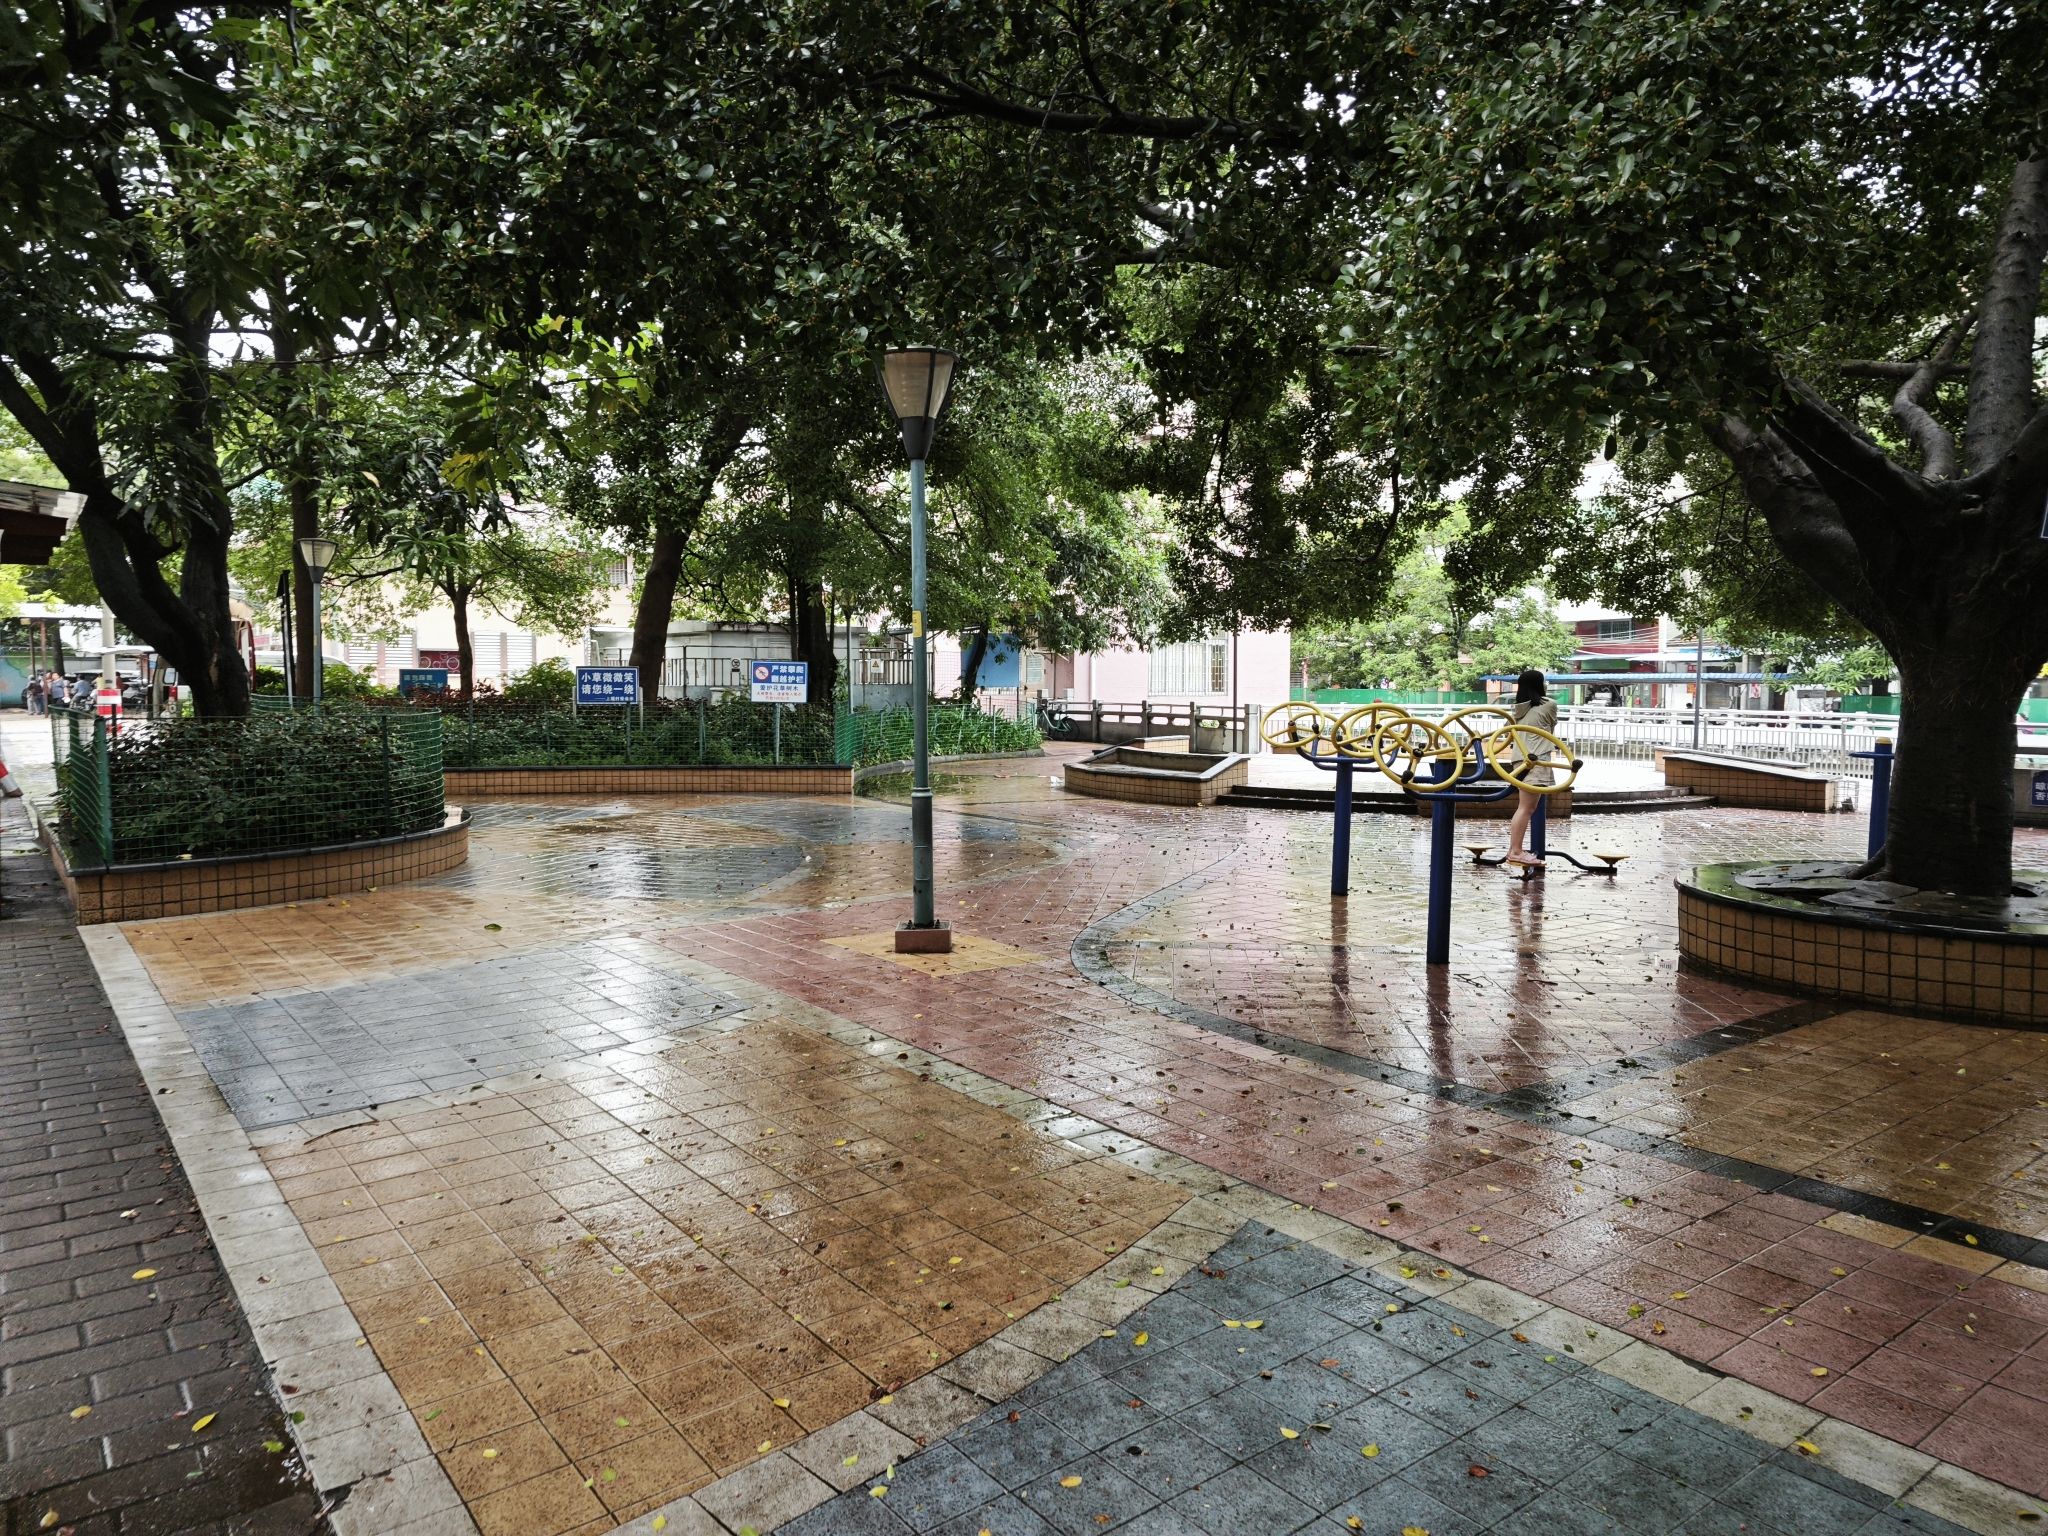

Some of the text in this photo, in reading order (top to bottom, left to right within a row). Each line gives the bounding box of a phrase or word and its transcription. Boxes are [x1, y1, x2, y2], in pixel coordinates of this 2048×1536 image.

[581, 672, 634, 683] 小草微微笑
[581, 684, 634, 694] 请您绕一绕
